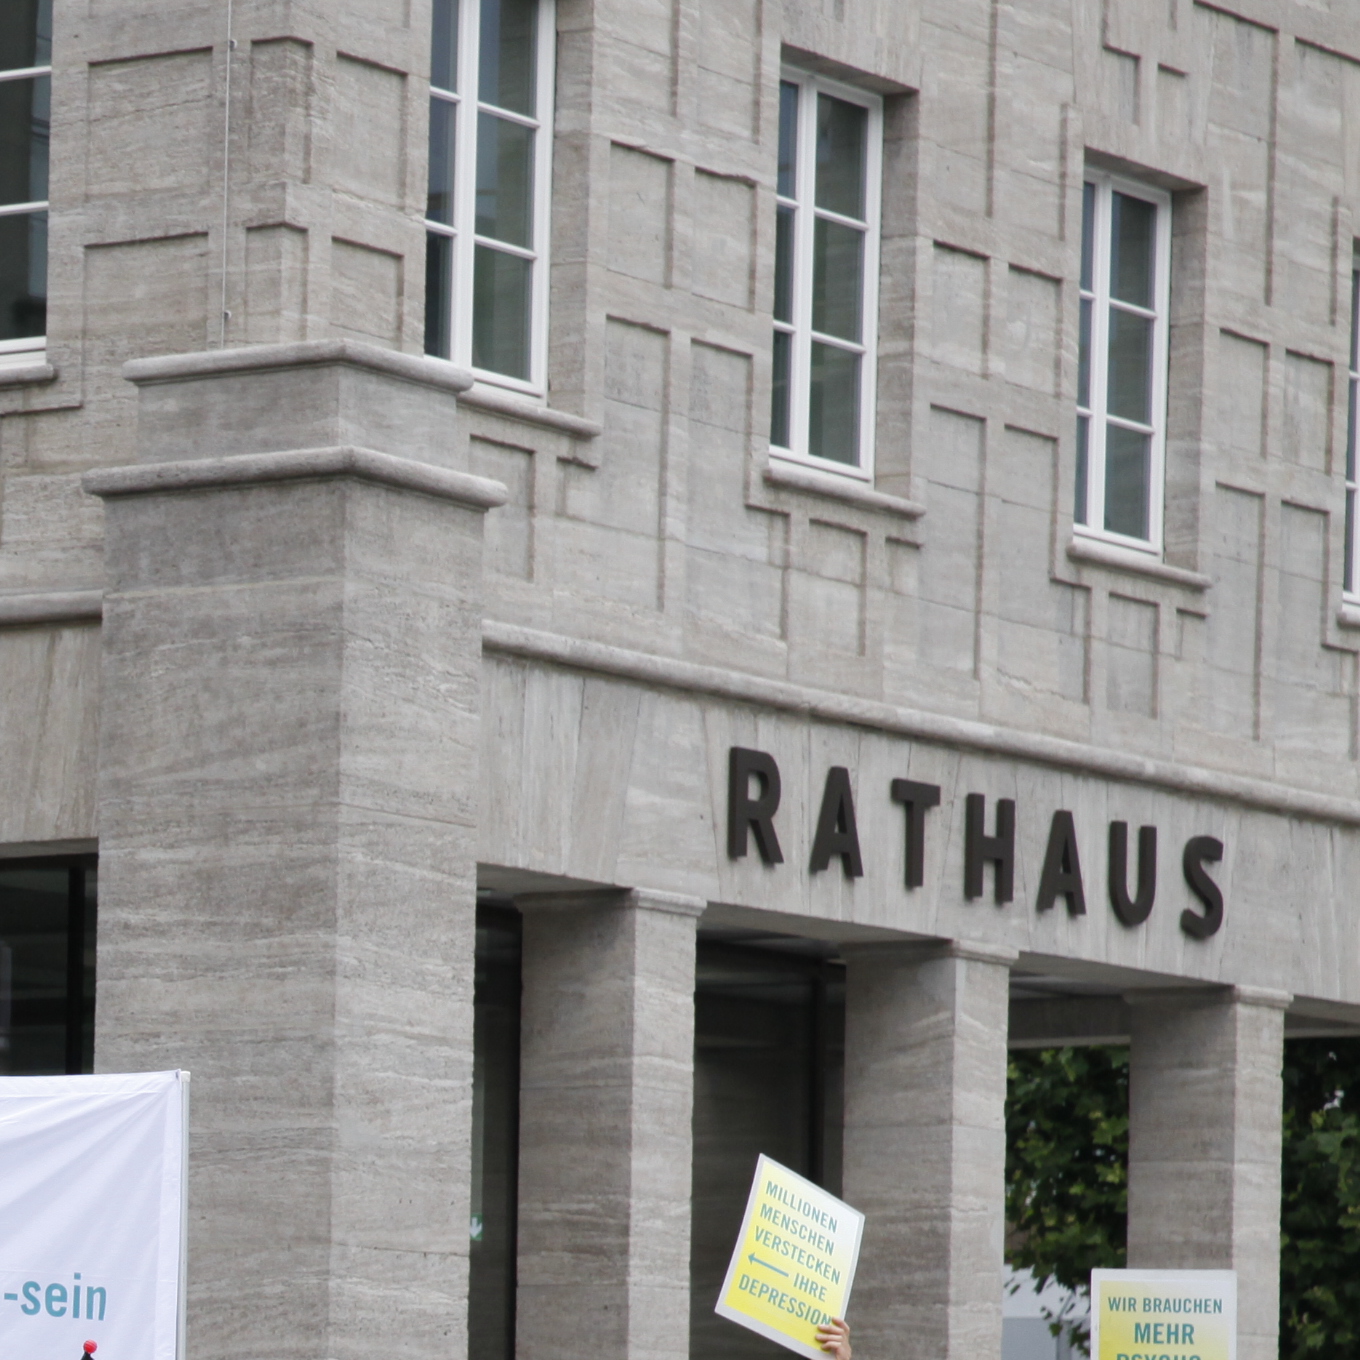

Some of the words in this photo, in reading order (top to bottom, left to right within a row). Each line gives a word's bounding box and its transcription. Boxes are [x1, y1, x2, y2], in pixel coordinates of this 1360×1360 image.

[727, 746, 1224, 940] RATHAUS
[760, 1203, 834, 1256] MENSCHEN
[766, 1180, 838, 1234] MILLIONEN
[755, 1225, 841, 1285] VERSTECKEN
[793, 1273, 828, 1303] IHRE
[1108, 1297, 1137, 1312] WIR
[1142, 1298, 1223, 1314] BRAUCHEN
[1134, 1322, 1195, 1345] MEHR
